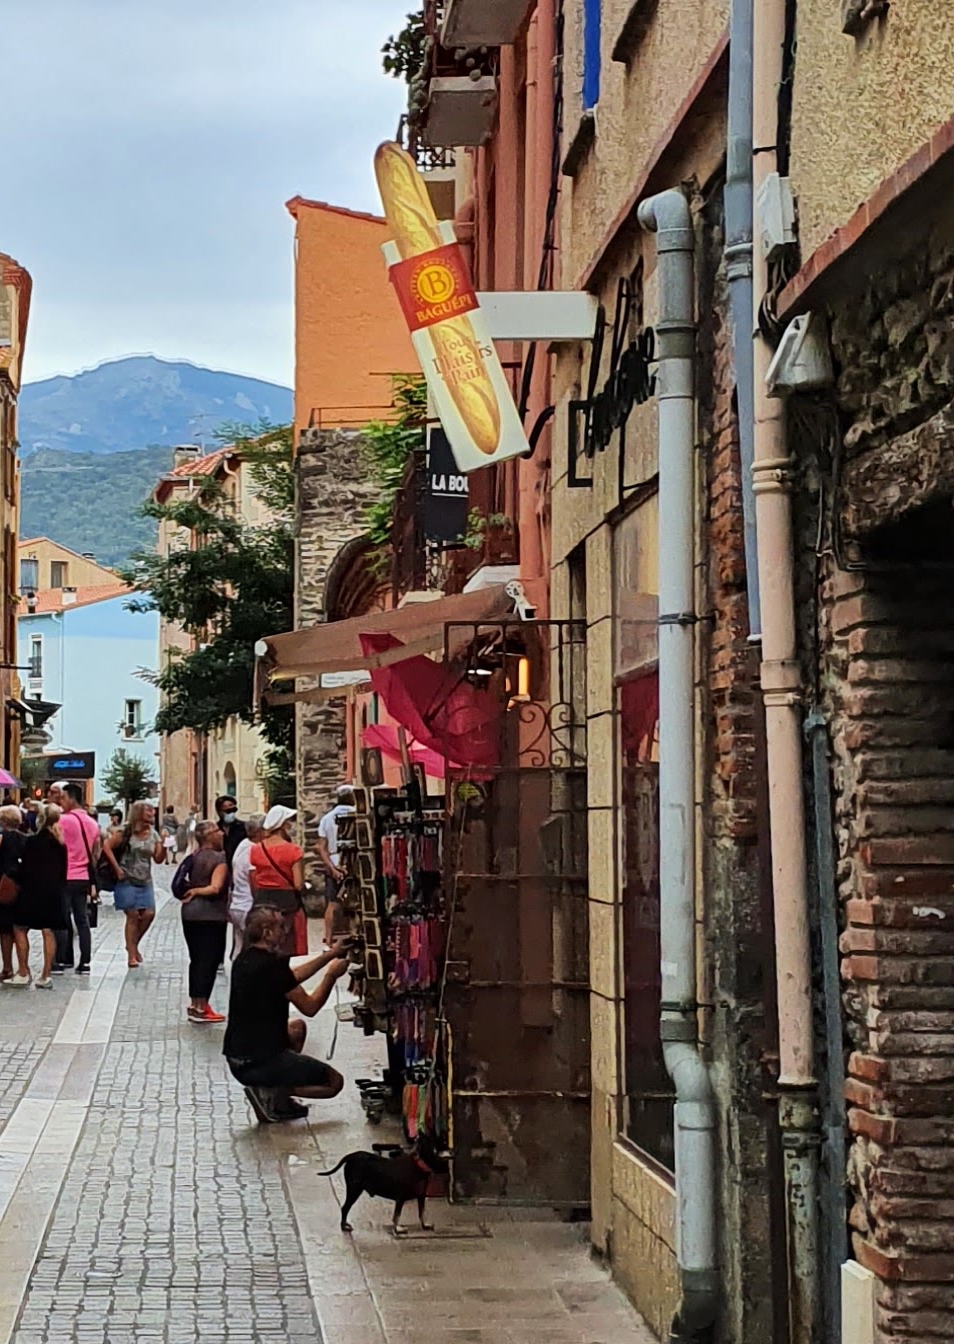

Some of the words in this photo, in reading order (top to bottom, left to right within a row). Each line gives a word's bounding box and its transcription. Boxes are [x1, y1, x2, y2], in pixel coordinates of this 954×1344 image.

[425, 270, 447, 295] B
[416, 293, 472, 323] BAGUÉPI
[432, 474, 446, 490] LA
